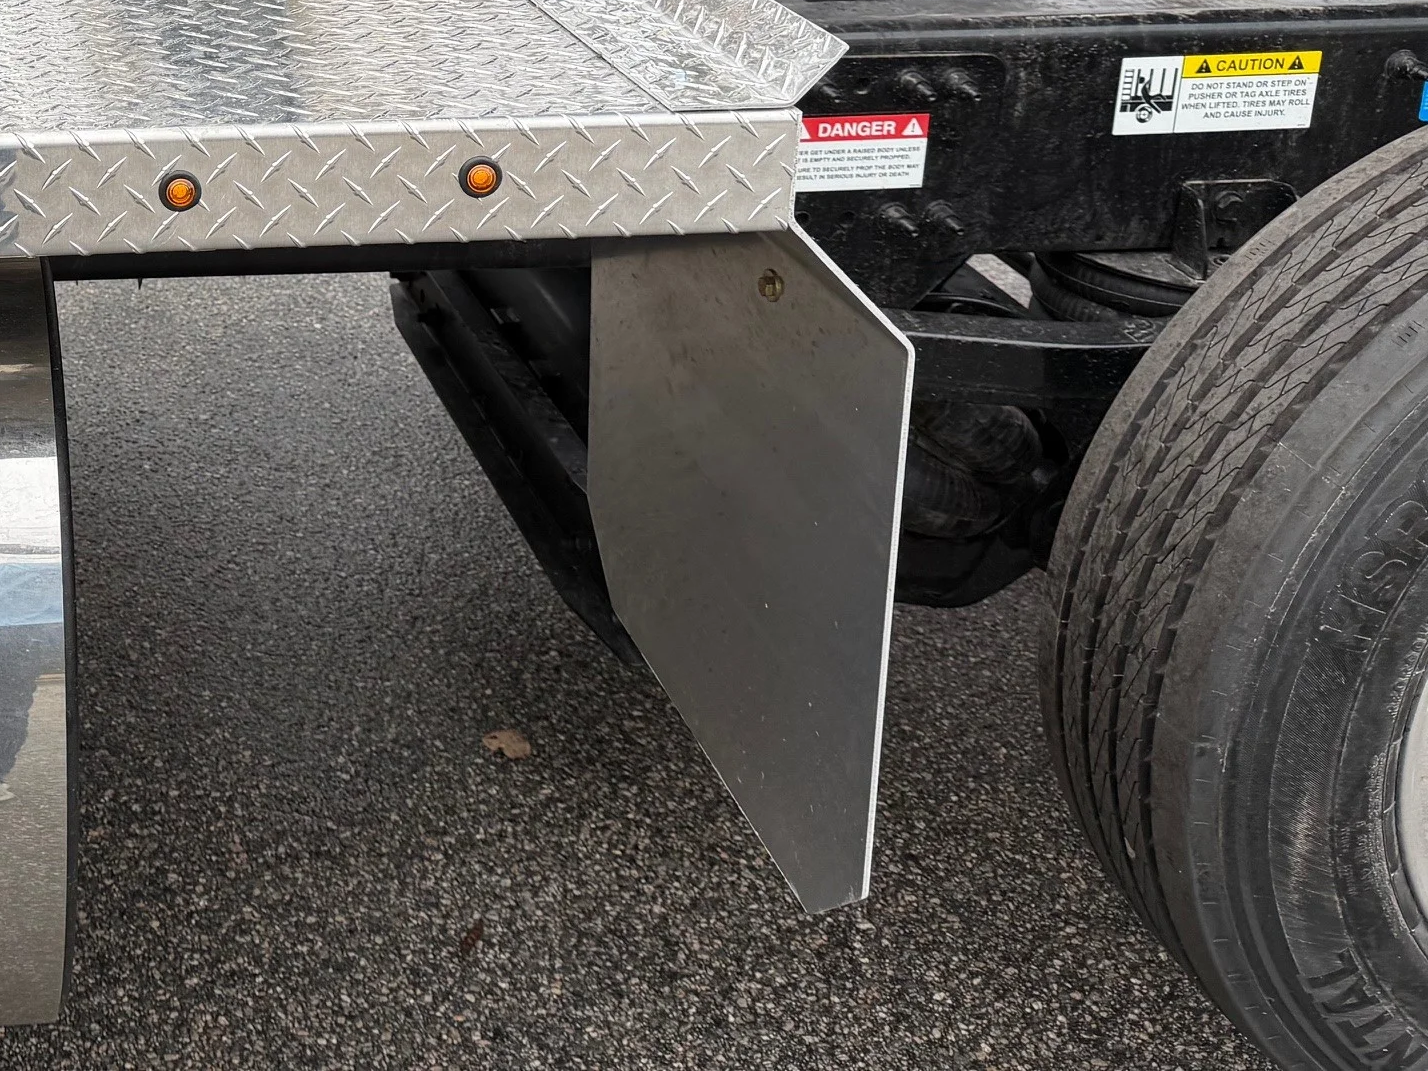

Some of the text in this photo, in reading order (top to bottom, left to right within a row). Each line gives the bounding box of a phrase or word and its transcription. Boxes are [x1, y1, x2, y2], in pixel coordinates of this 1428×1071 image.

[1216, 58, 1286, 72] CAUTION
[1191, 79, 1307, 90] DO NOT STAND OR STEP ON
[1188, 92, 1222, 100] PUSHER
[1224, 91, 1238, 99] OR
[1239, 90, 1256, 98] TAG
[1181, 102, 1206, 110] WHEN
[1208, 101, 1241, 109] LIFTED.
[1268, 99, 1287, 107] MAY
[1288, 98, 1310, 106] ROLL
[1202, 109, 1286, 119] AND CAUSE INJURY.
[817, 120, 897, 138] DANGER
